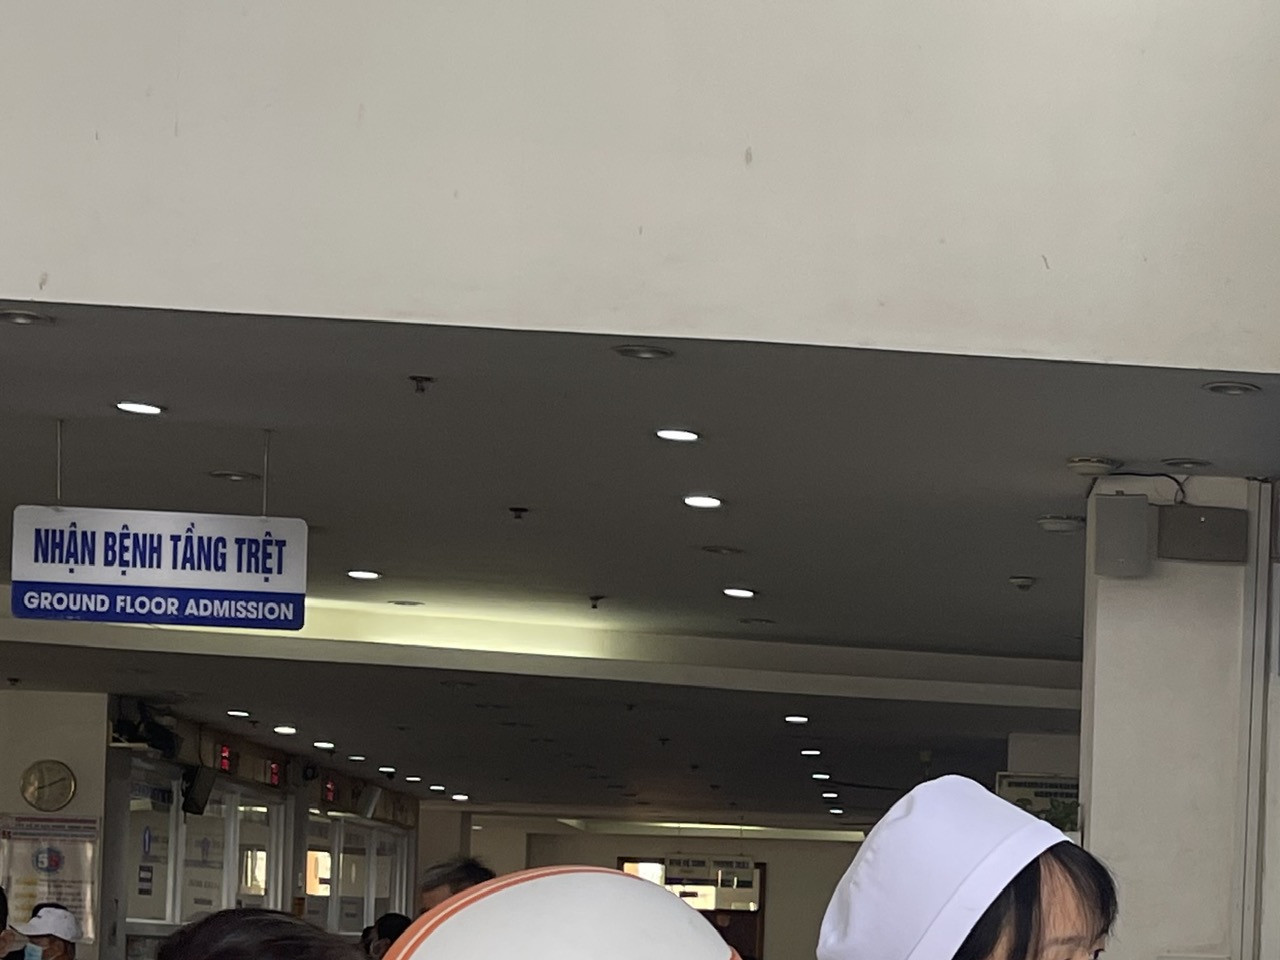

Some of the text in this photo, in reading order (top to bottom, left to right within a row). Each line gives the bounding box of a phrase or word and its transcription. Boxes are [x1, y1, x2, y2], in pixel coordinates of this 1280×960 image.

[34, 522, 287, 583] NHẬN BỆNH TẦNG TRỆT
[24, 591, 294, 621] GROUND FLOOR ADMISSION
